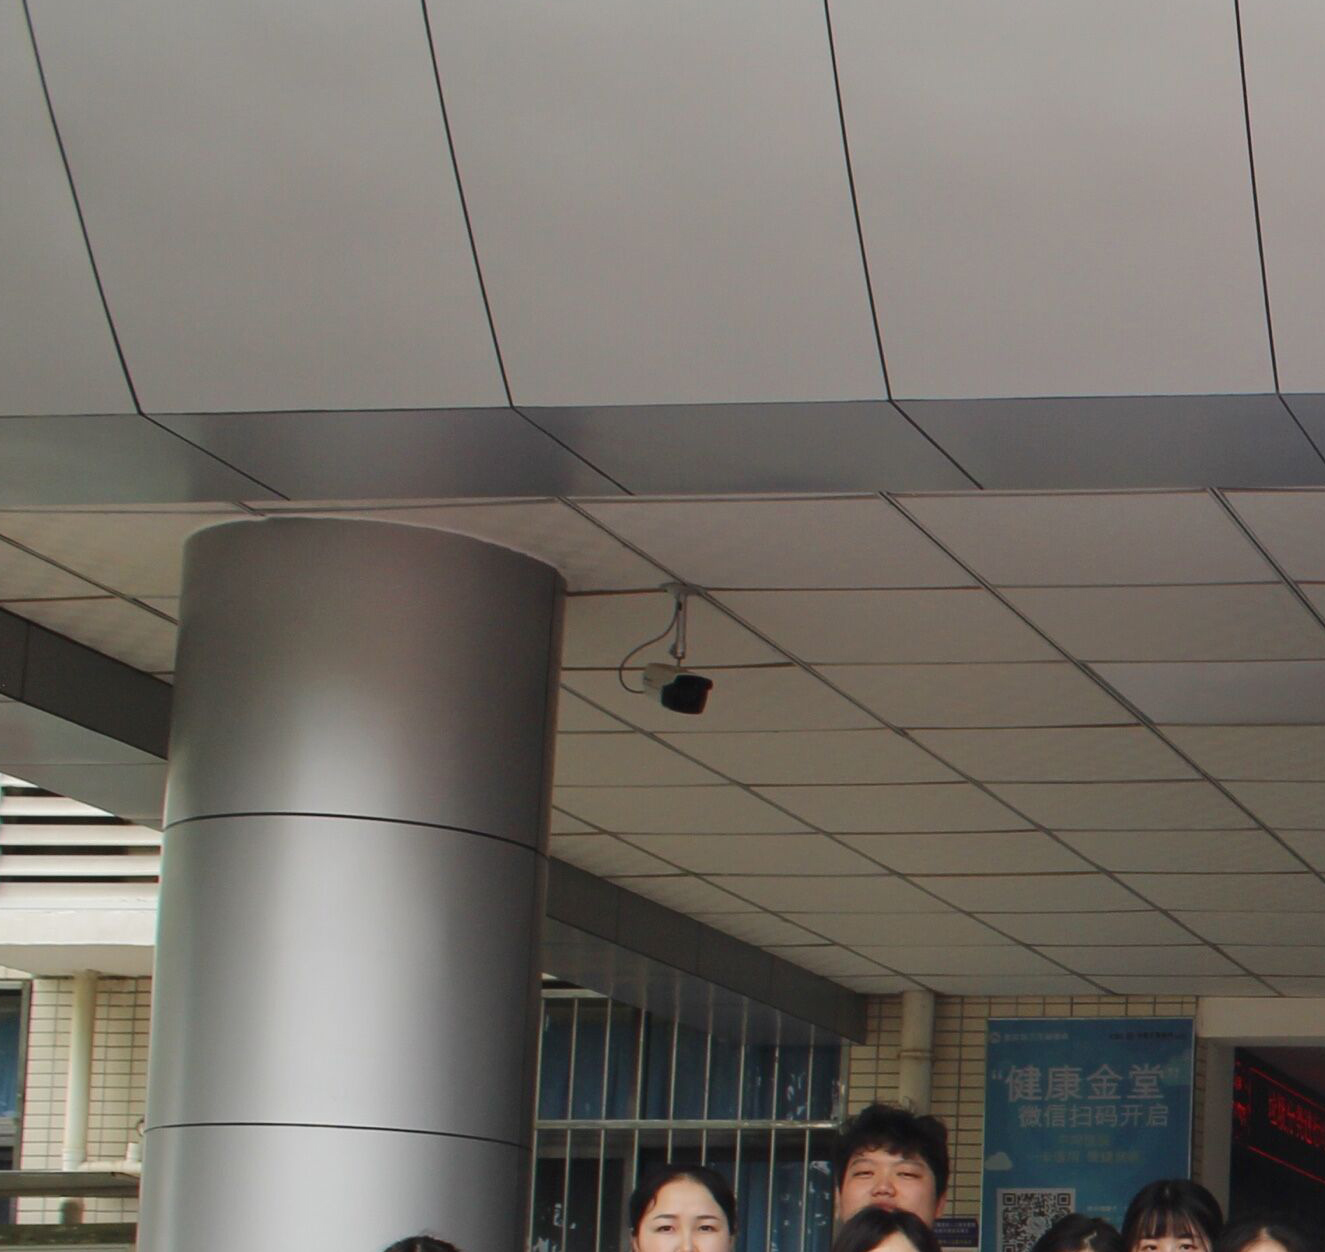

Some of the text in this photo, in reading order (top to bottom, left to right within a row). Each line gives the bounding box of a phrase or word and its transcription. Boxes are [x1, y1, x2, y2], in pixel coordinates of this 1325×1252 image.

[1018, 1104, 1169, 1128] 微信扫码开启
